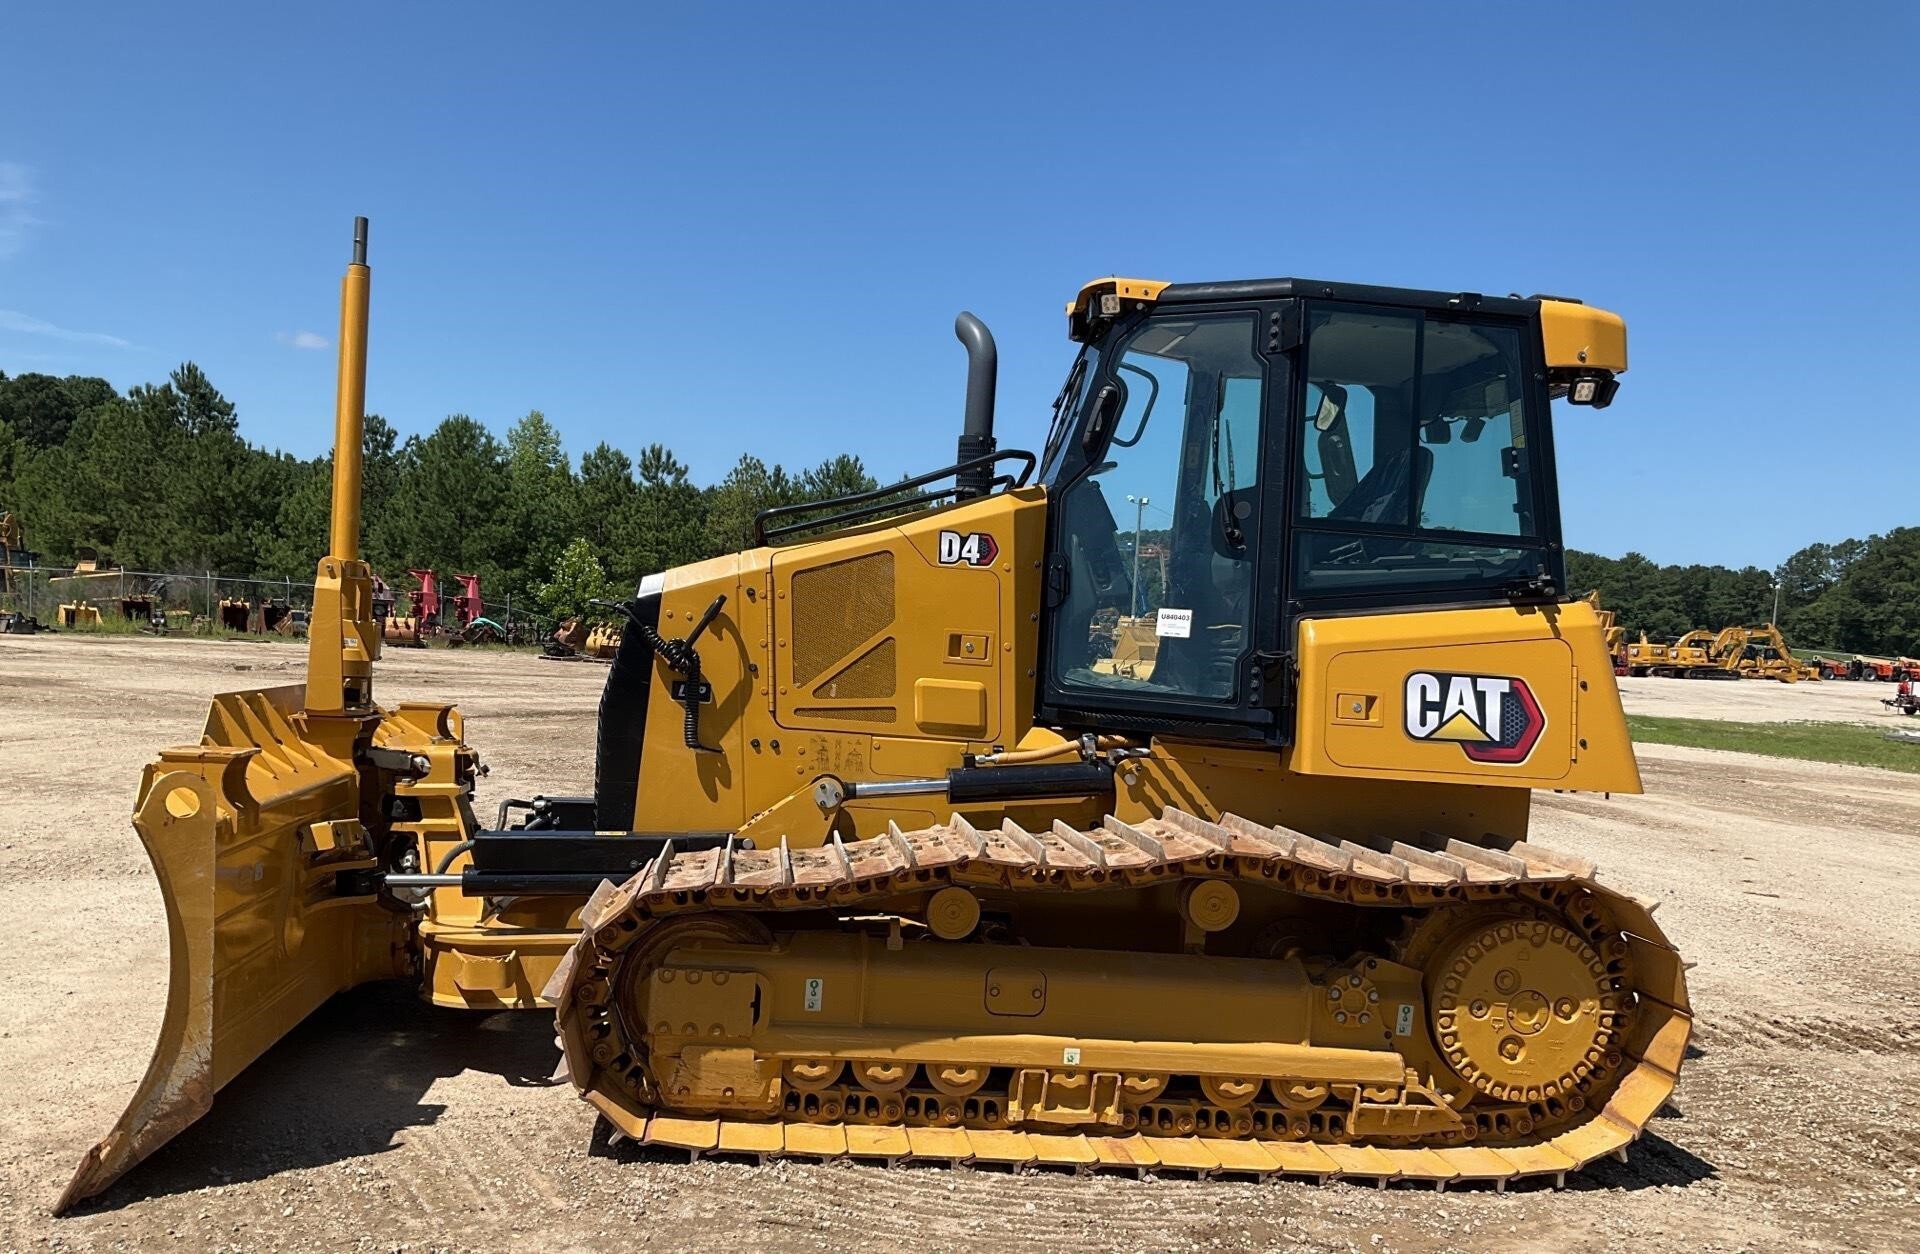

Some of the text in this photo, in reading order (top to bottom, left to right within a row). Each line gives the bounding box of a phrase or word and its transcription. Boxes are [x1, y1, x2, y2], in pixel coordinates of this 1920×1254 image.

[940, 532, 980, 564] D4
[678, 684, 707, 697] LP
[1406, 673, 1510, 742] CAT
